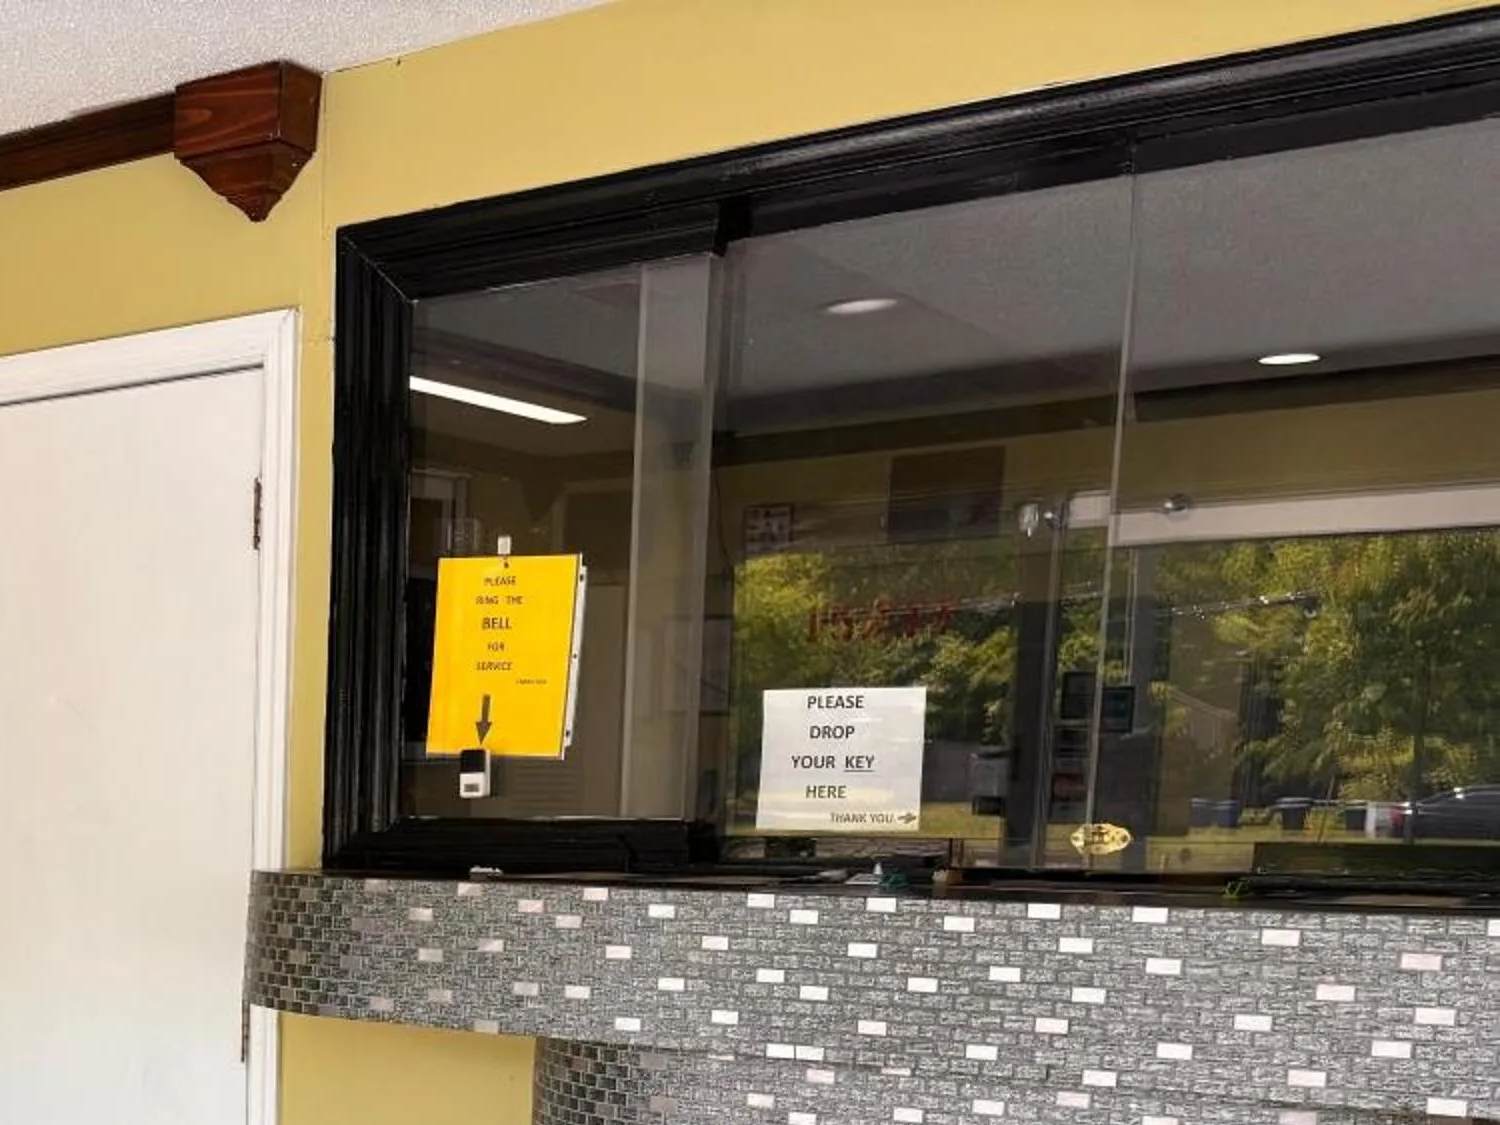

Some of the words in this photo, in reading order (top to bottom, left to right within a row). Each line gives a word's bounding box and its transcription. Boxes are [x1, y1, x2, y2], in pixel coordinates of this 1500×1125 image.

[483, 576, 516, 586] PLEASE
[482, 617, 512, 630] BELL
[807, 695, 864, 709] PLEASE
[809, 725, 855, 739] DROP
[791, 755, 835, 769] YOUR
[845, 755, 875, 769] KEY
[805, 785, 847, 799] HERE
[830, 812, 867, 824] THANK
